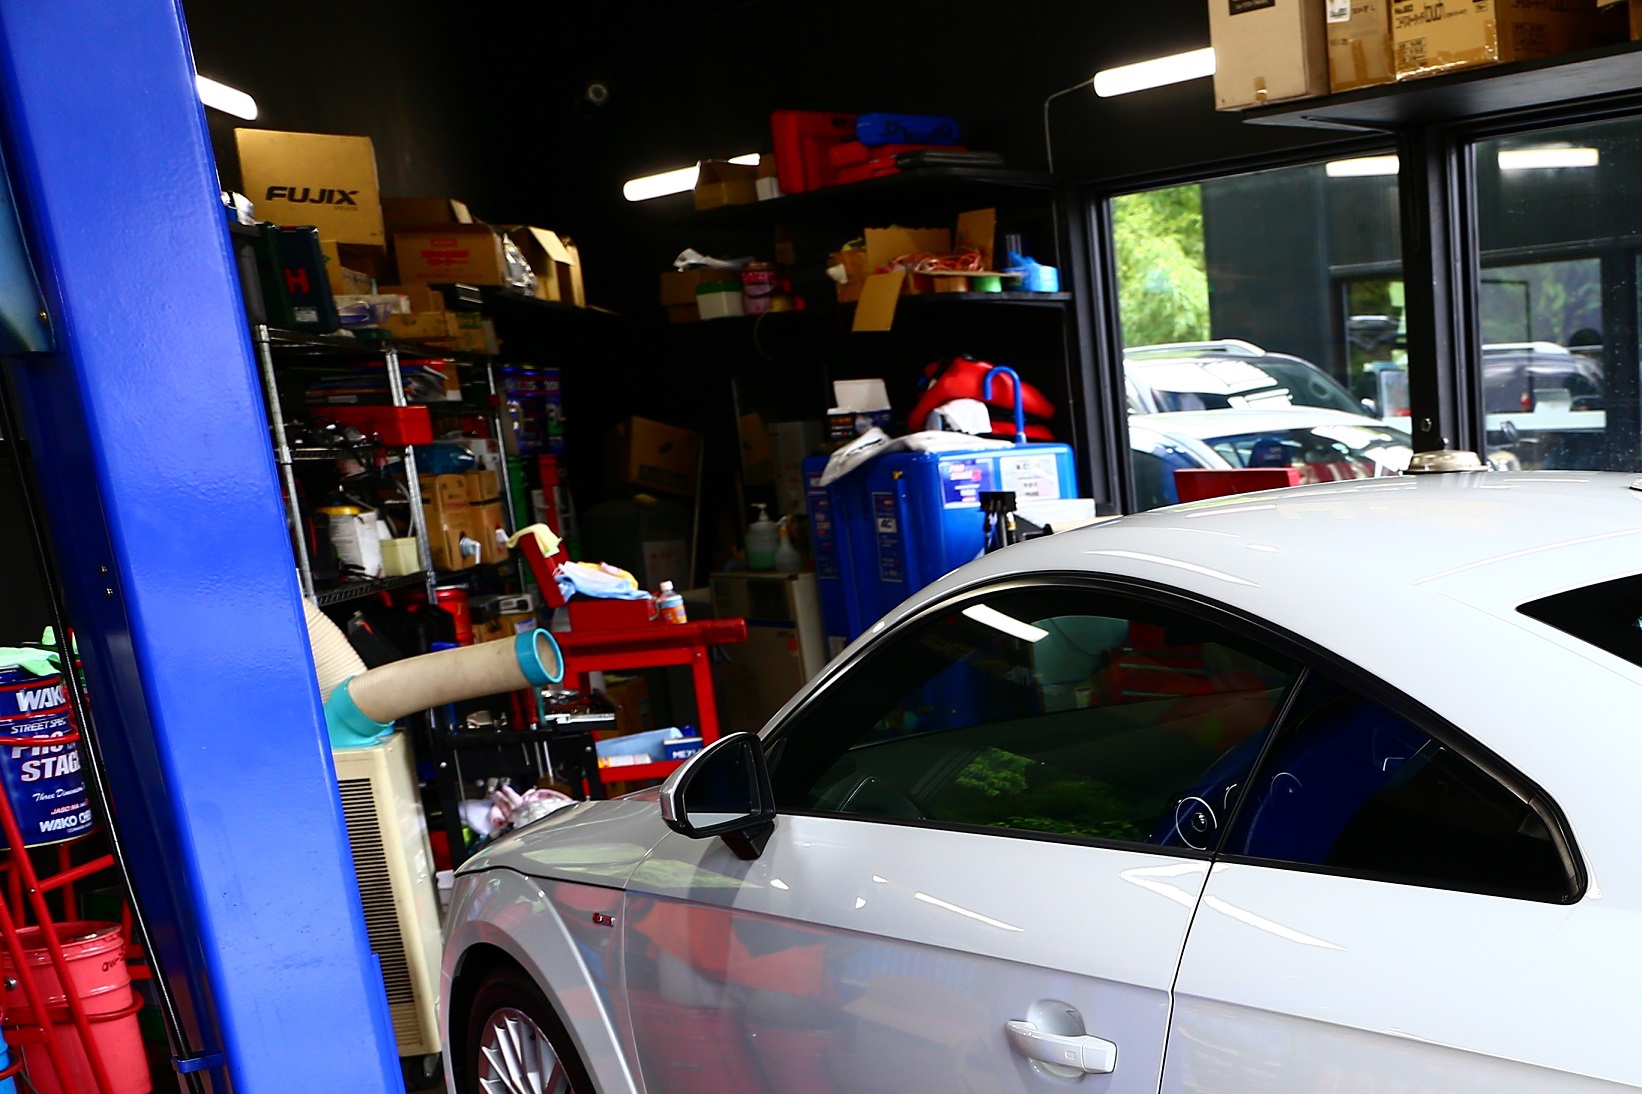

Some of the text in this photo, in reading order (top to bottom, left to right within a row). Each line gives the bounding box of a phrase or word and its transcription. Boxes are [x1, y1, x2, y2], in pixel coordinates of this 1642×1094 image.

[265, 186, 359, 206] FUJIX
[15, 684, 67, 712] WAK
[10, 720, 49, 734] STREET
[20, 750, 81, 782] STAG
[39, 815, 78, 833] WAKO
